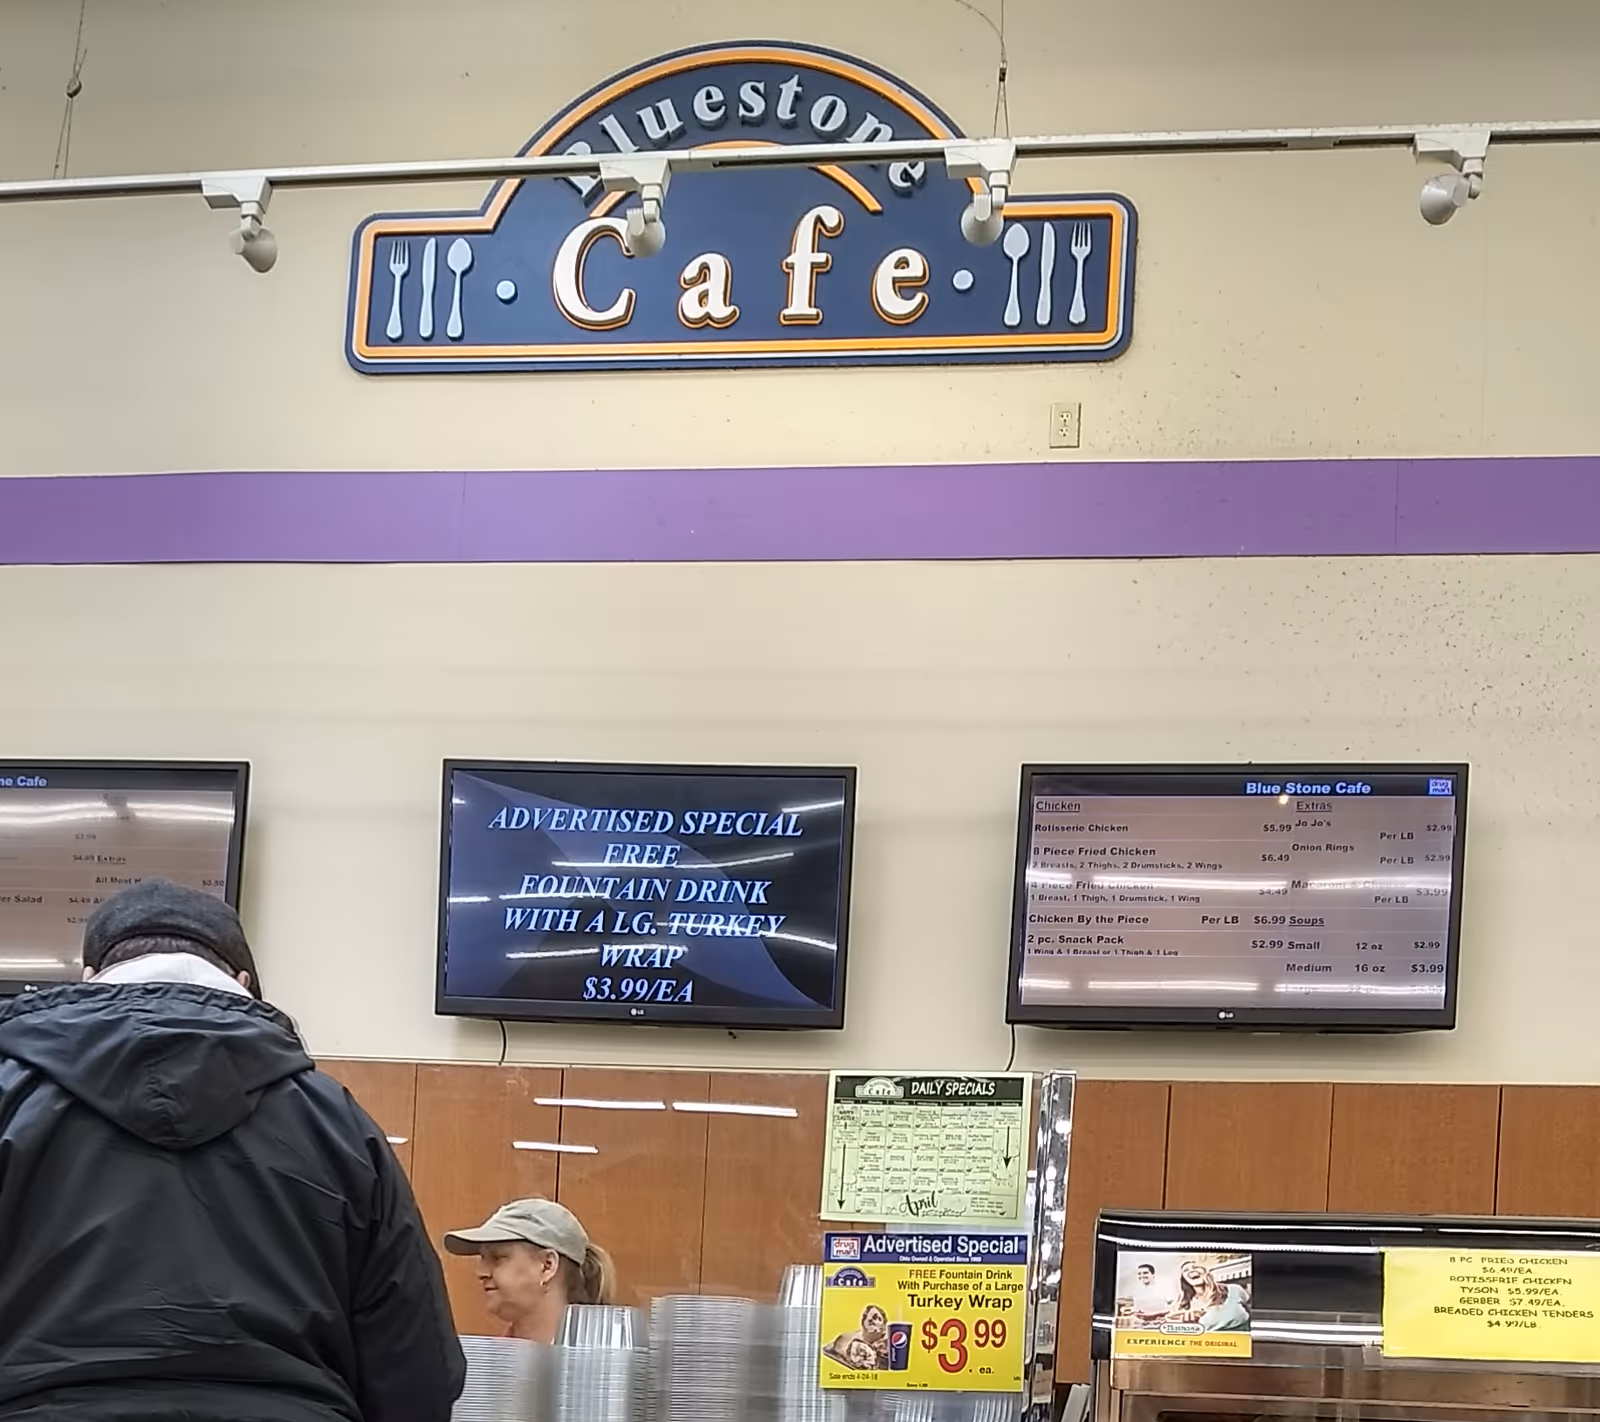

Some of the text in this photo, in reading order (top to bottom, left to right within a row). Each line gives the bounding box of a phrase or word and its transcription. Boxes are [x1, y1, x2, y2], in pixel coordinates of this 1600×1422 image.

[553, 206, 930, 330] Cafe
[17, 776, 47, 787] Cafe
[1246, 782, 1371, 794] Blue Stone Cafe
[1036, 801, 1081, 812] Chicken
[1296, 801, 1332, 811] Extras
[489, 806, 803, 836] ADVERTISED SPECIAL
[1294, 819, 1307, 827] Jo
[1034, 824, 1128, 832] Rotisserie Chicken
[1263, 824, 1292, 832] $5.99
[1426, 824, 1452, 832] $2.99
[1380, 832, 1414, 840] Per LB
[1033, 847, 1156, 856] 8 Piece Fried Chicken
[1292, 843, 1354, 853] Onion Rings
[603, 843, 680, 867] FREE
[1261, 854, 1290, 862] $6.49
[1194, 862, 1223, 870] Wings
[520, 874, 772, 904] FOUNTAIN DRINK
[1076, 881, 1104, 889] Fried
[1416, 888, 1448, 896] $3.99
[15, 895, 42, 904] Salad
[1177, 895, 1200, 903] Wing
[1374, 896, 1409, 904] Per LB
[504, 907, 786, 937] WITH A LG. TURKEY
[1029, 914, 1149, 926] Chicken By the Piece
[1201, 916, 1239, 924] Per LB
[1254, 916, 1325, 926] $6.99 Soups
[1027, 935, 1124, 945] 2 pc. Snack Pack
[1251, 940, 1283, 949] $2.99
[1287, 941, 1320, 950] Small
[1355, 942, 1367, 950] 12
[1414, 941, 1440, 949] $2.99
[600, 944, 683, 968] WRAP
[1286, 963, 1444, 973] Medium 16 oz $3.99
[583, 976, 693, 1003] $3.99/EA
[911, 1081, 995, 1096] DAILY SPECIALS
[900, 1191, 938, 1217] April
[834, 1239, 855, 1250] drug
[863, 1235, 1018, 1257] Advertised Special
[909, 1270, 1012, 1279] FREE Fountain Drink
[1450, 1276, 1518, 1284] ROTISSERIE
[898, 1281, 920, 1290] With
[923, 1281, 969, 1290] Purchase
[972, 1281, 983, 1290] of
[995, 1282, 1023, 1293] Large
[1460, 1286, 1498, 1294] TYSON
[907, 1293, 1012, 1311] Turkey Wrap
[1459, 1297, 1500, 1305] GERBER
[1434, 1306, 1594, 1318] BREADED CHICKEN TENDERS
[1127, 1338, 1186, 1346] EXPERIENCE
